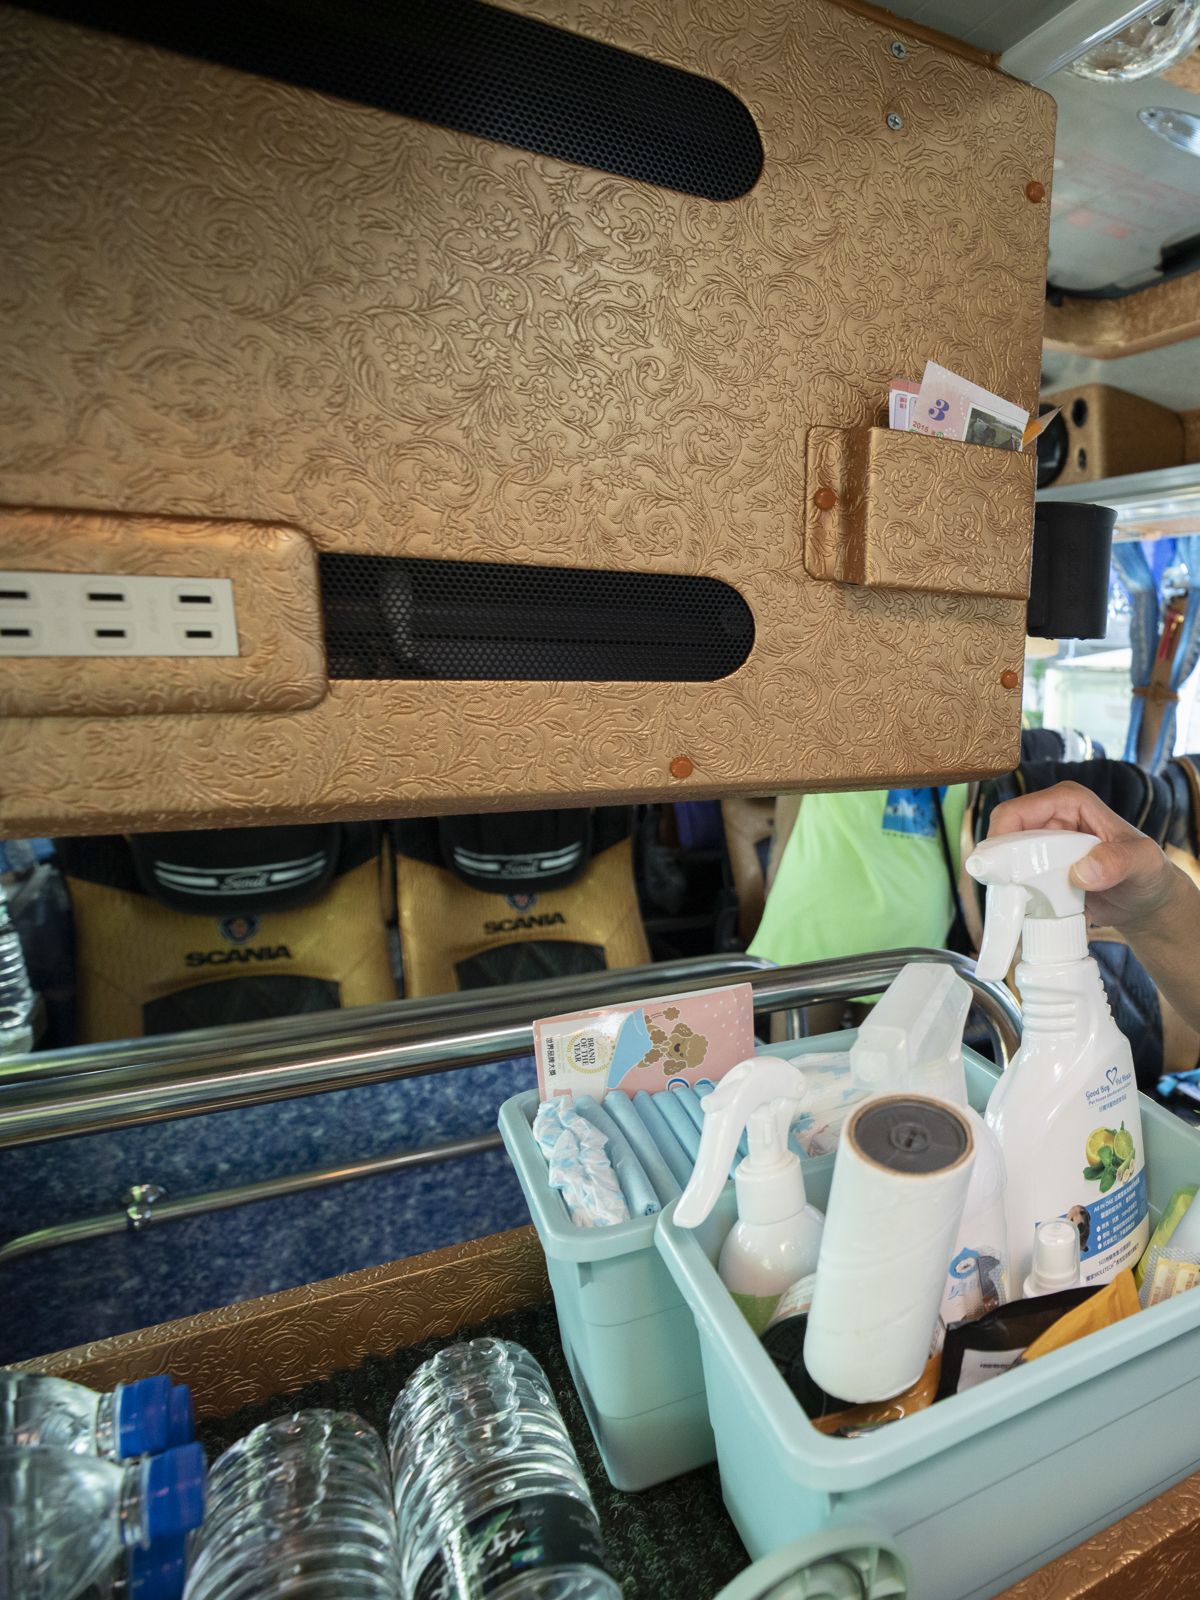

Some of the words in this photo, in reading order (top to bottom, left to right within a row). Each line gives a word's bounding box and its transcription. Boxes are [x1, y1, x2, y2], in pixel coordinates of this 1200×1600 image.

[928, 399, 950, 421] 3
[484, 911, 566, 934] SCANIA
[184, 945, 292, 967] SCANIA
[573, 1043, 581, 1063] YEAR
[580, 1037, 587, 1049] OF
[587, 1037, 596, 1064] BRAND
[581, 1050, 589, 1066] THE
